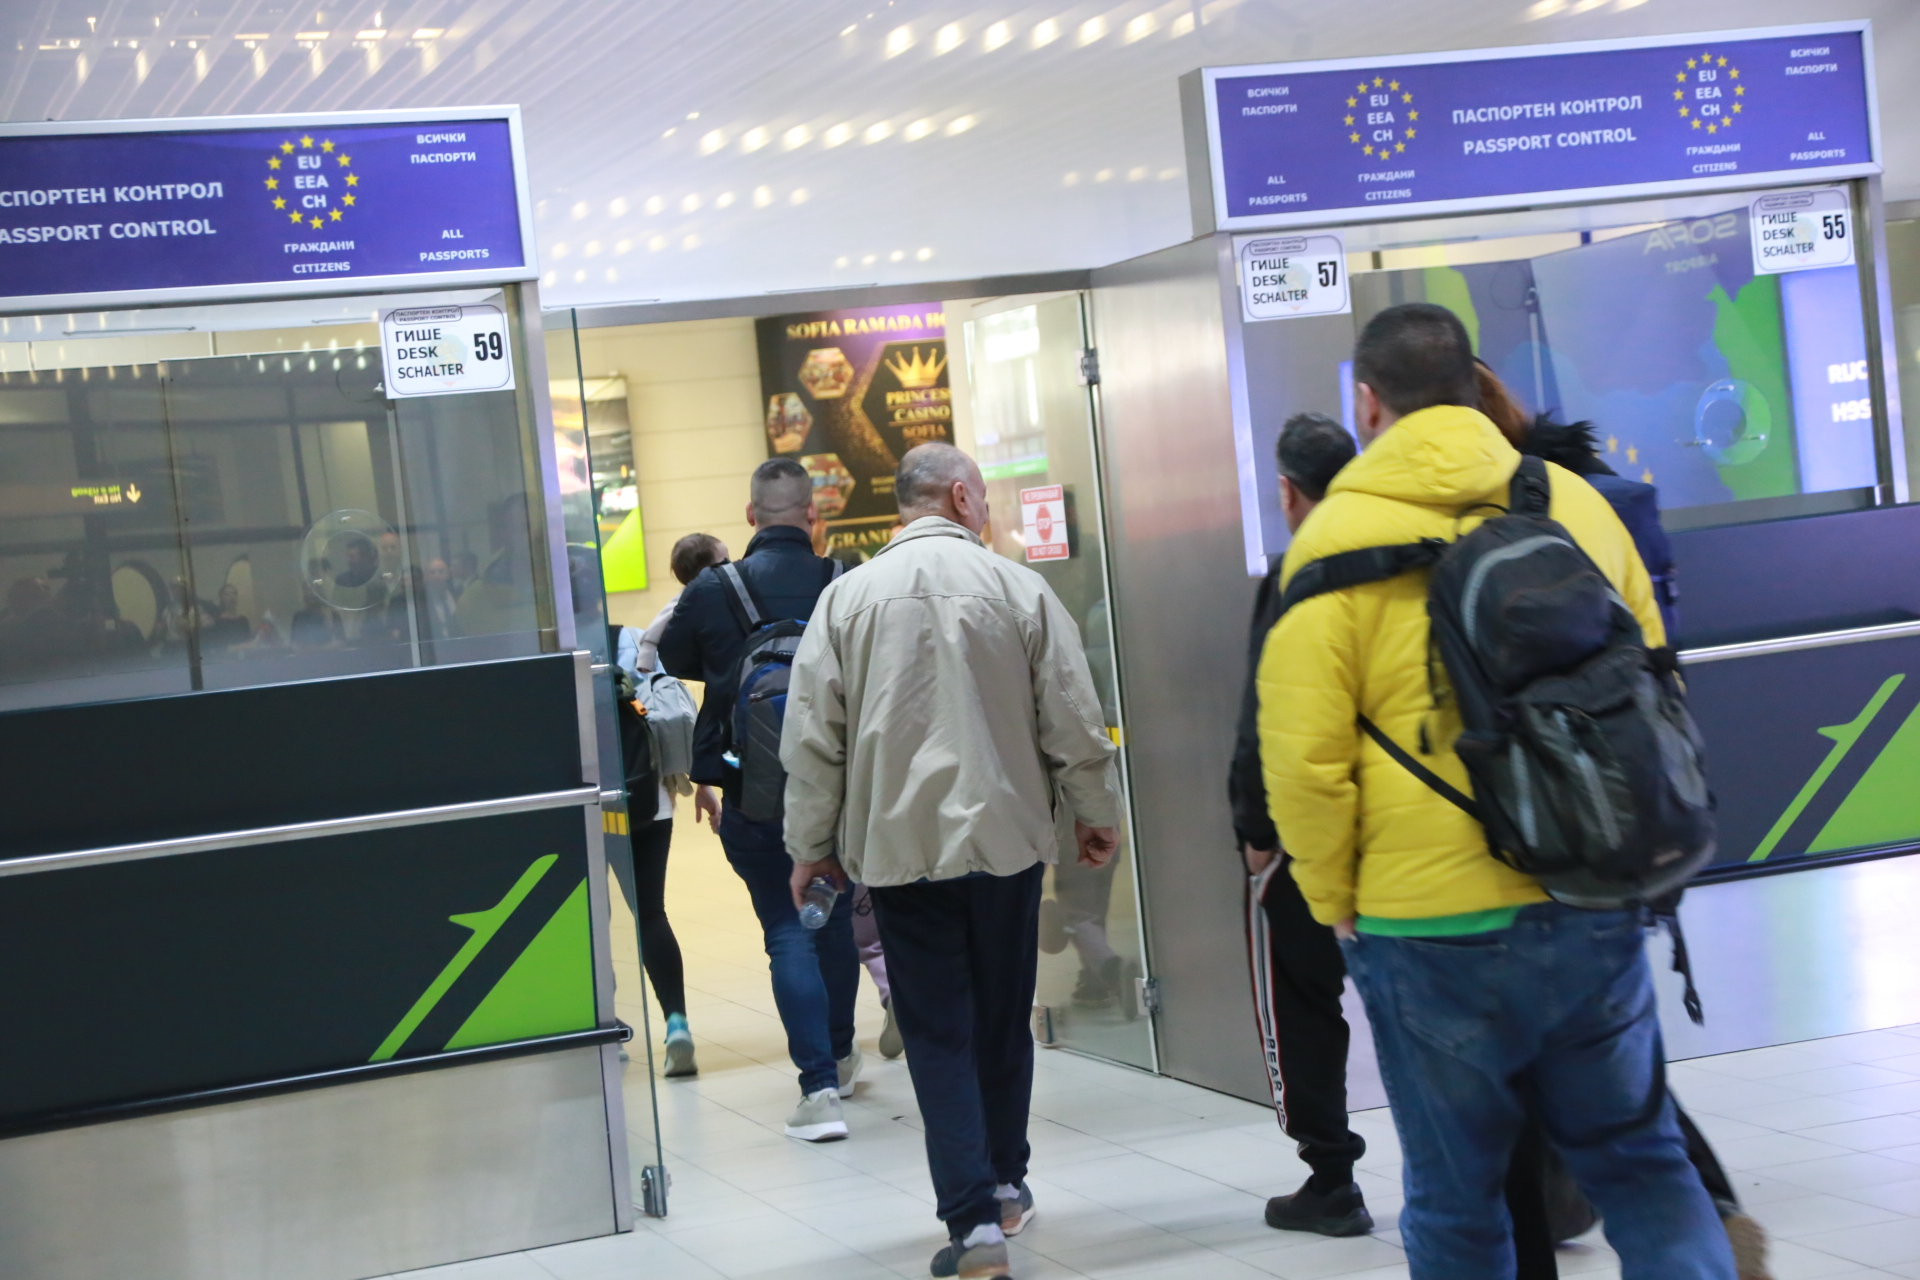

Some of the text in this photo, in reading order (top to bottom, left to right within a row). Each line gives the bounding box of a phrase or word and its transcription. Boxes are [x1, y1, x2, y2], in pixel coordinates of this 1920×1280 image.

[1790, 47, 1830, 58] ВСИЧКИ
[1785, 63, 1837, 75] ПАСПОРТИ
[1698, 70, 1717, 82] EU
[1247, 87, 1289, 98] ВСИЧКИ
[1695, 87, 1722, 99] EEA
[1370, 94, 1389, 107] EU
[1242, 104, 1297, 116] ПАСПОРТИ
[1452, 95, 1642, 124] ПАСПОРТЕН КОНТРОЛ
[1701, 104, 1720, 116] CH
[1367, 112, 1395, 125] EEA
[417, 133, 466, 144] ВСИЧКИ
[1373, 129, 1393, 142] CH
[1463, 127, 1636, 155] PASSPORT CONTROL
[1808, 132, 1826, 141] ALL
[1686, 143, 1741, 156] ГРАЖДАНИ
[1790, 149, 1846, 161] PASSPORTS
[297, 156, 321, 169] EU
[410, 152, 476, 164] ПАСПОРТИ
[1692, 162, 1737, 173] CITIZENS
[294, 175, 329, 189] EEA
[1267, 175, 1286, 185] ALL
[1358, 170, 1415, 183] ГРАЖДАНИ
[0, 182, 224, 207] СПОРТЕН КОНТРОЛ
[302, 194, 327, 208] CH
[1249, 193, 1308, 206] PASSPORTS
[1365, 189, 1411, 200] CITIZENS
[1761, 212, 1798, 225] ГИШЕ
[109, 219, 217, 239] CONTROL
[1823, 214, 1845, 240] 55
[442, 229, 464, 239] ALL
[1763, 228, 1795, 241] DESK
[284, 240, 355, 253] ГРАЖДАНИ
[1763, 242, 1815, 257] SCHALTER
[420, 249, 489, 262] PASSPORTS
[293, 262, 350, 273] CITIZENS
[1251, 257, 1289, 271] ГИШЕ
[1253, 274, 1287, 287] DESK
[1318, 261, 1337, 287] 57
[1253, 289, 1308, 305] SCHALTER
[786, 319, 841, 339] SOFIA
[843, 314, 923, 335] RAMADA
[395, 328, 441, 342] ГИШЕ
[397, 346, 438, 360] DESK
[474, 332, 503, 361] 59
[398, 363, 464, 379] SCHALTER
[894, 405, 950, 421] CASINO
